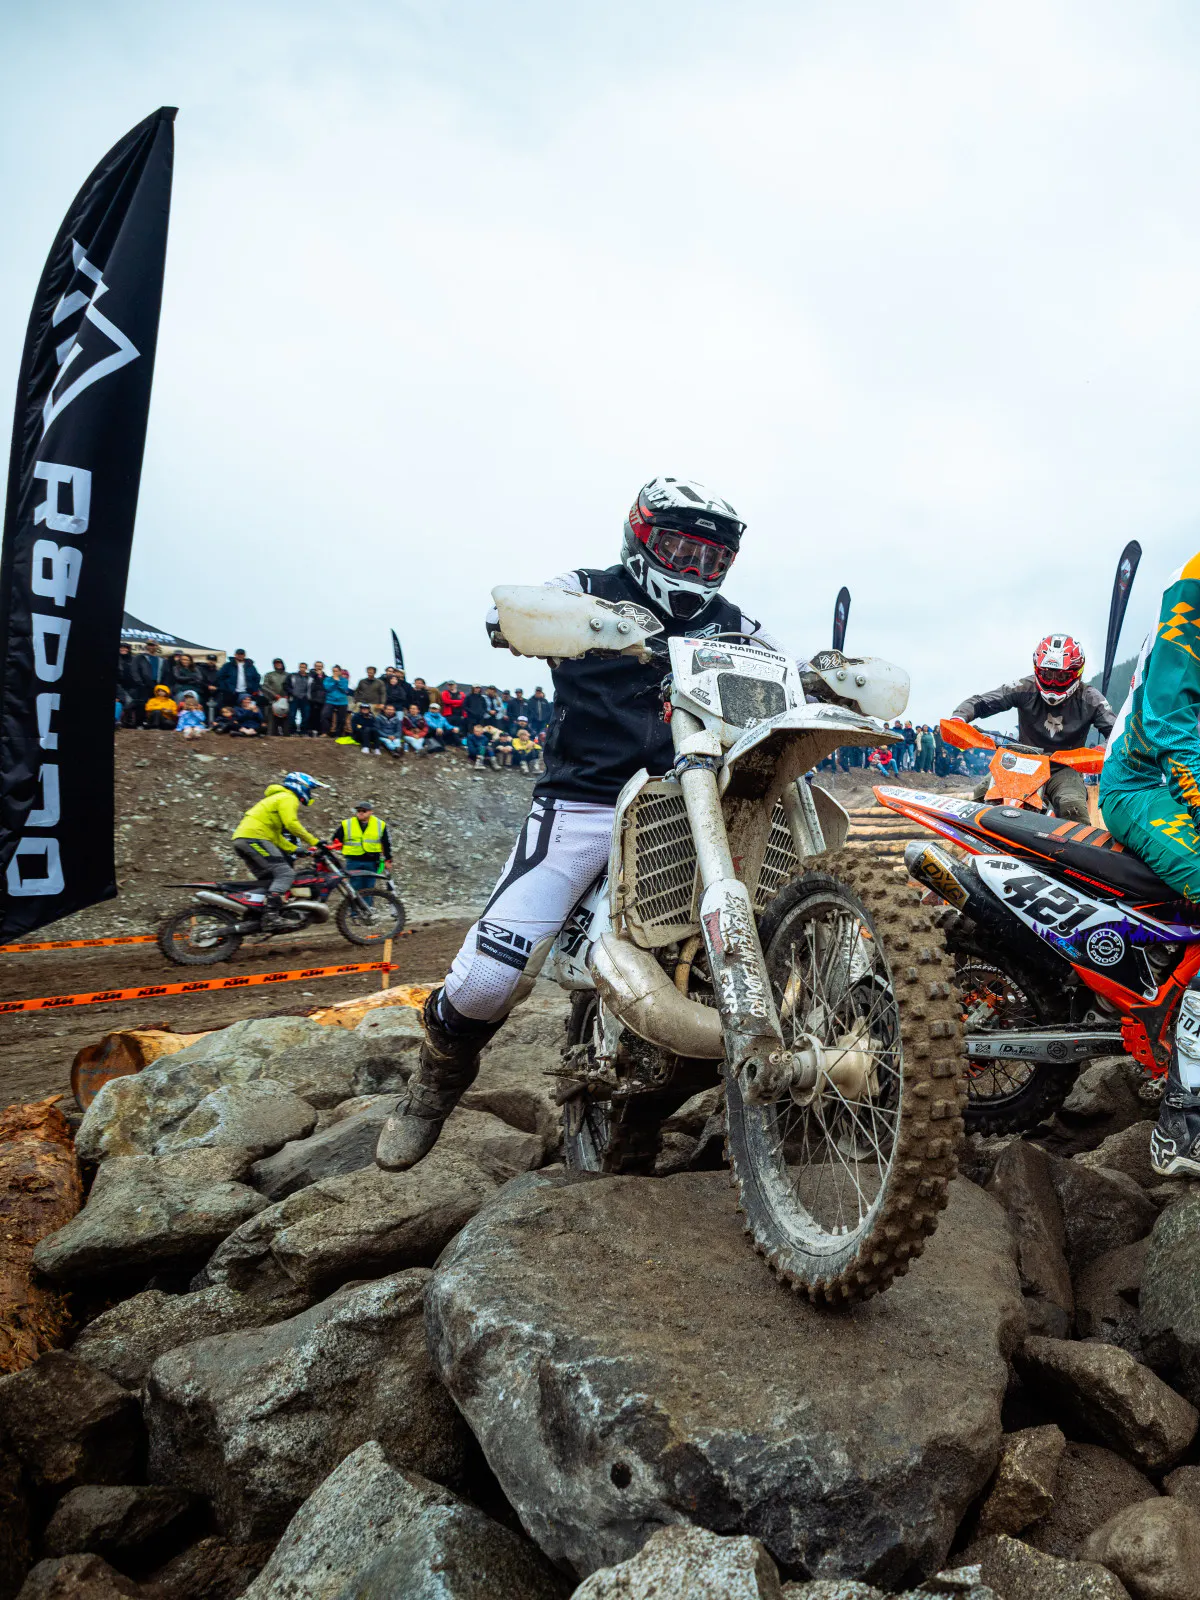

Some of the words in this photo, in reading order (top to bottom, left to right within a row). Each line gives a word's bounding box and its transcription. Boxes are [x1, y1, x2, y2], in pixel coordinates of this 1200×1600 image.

[702, 641, 726, 649] ZAK
[729, 644, 786, 663] HAMMOND
[554, 803, 565, 844] HLIUM
[1002, 875, 1101, 935] 421
[497, 949, 525, 967] STRETC
[1090, 931, 1122, 947] BULLET
[1090, 950, 1120, 964] PROOF
[41, 997, 75, 1009] KTM
[91, 992, 123, 1003] KTM
[137, 986, 168, 997] KTM
[181, 981, 210, 991] KTM
[223, 977, 250, 987] KTM
[263, 973, 289, 983] KTM
[300, 969, 325, 978] KTM
[336, 965, 361, 974] KTM
[720, 967, 739, 1015] FXR
[741, 961, 768, 1018] ENDURO
